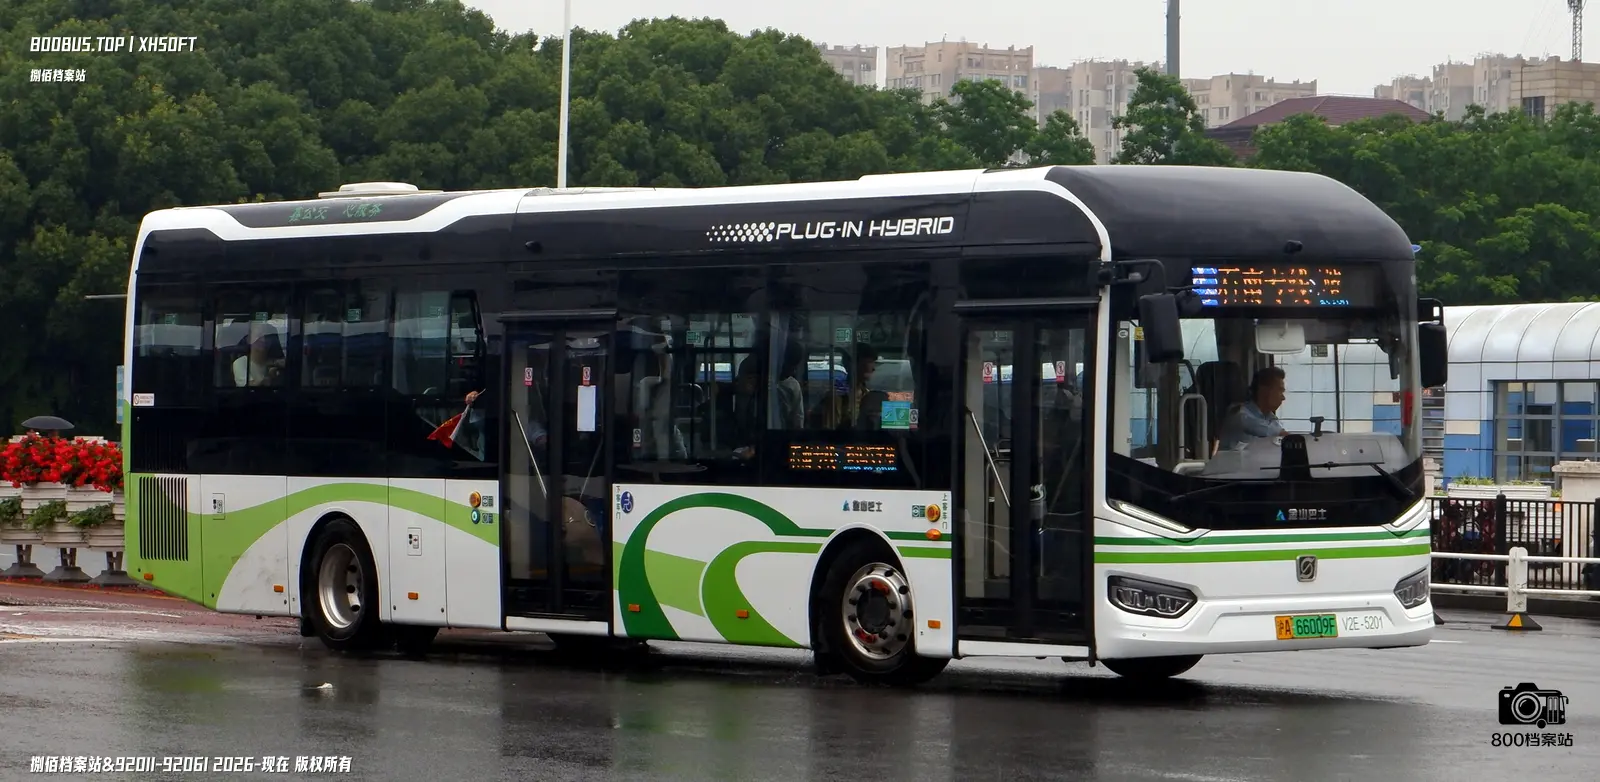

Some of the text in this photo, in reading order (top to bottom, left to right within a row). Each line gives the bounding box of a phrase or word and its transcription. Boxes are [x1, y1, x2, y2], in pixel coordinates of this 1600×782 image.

[776, 216, 954, 240] PLUG-IN HYBRID
[1342, 615, 1384, 632] V2E-5201
